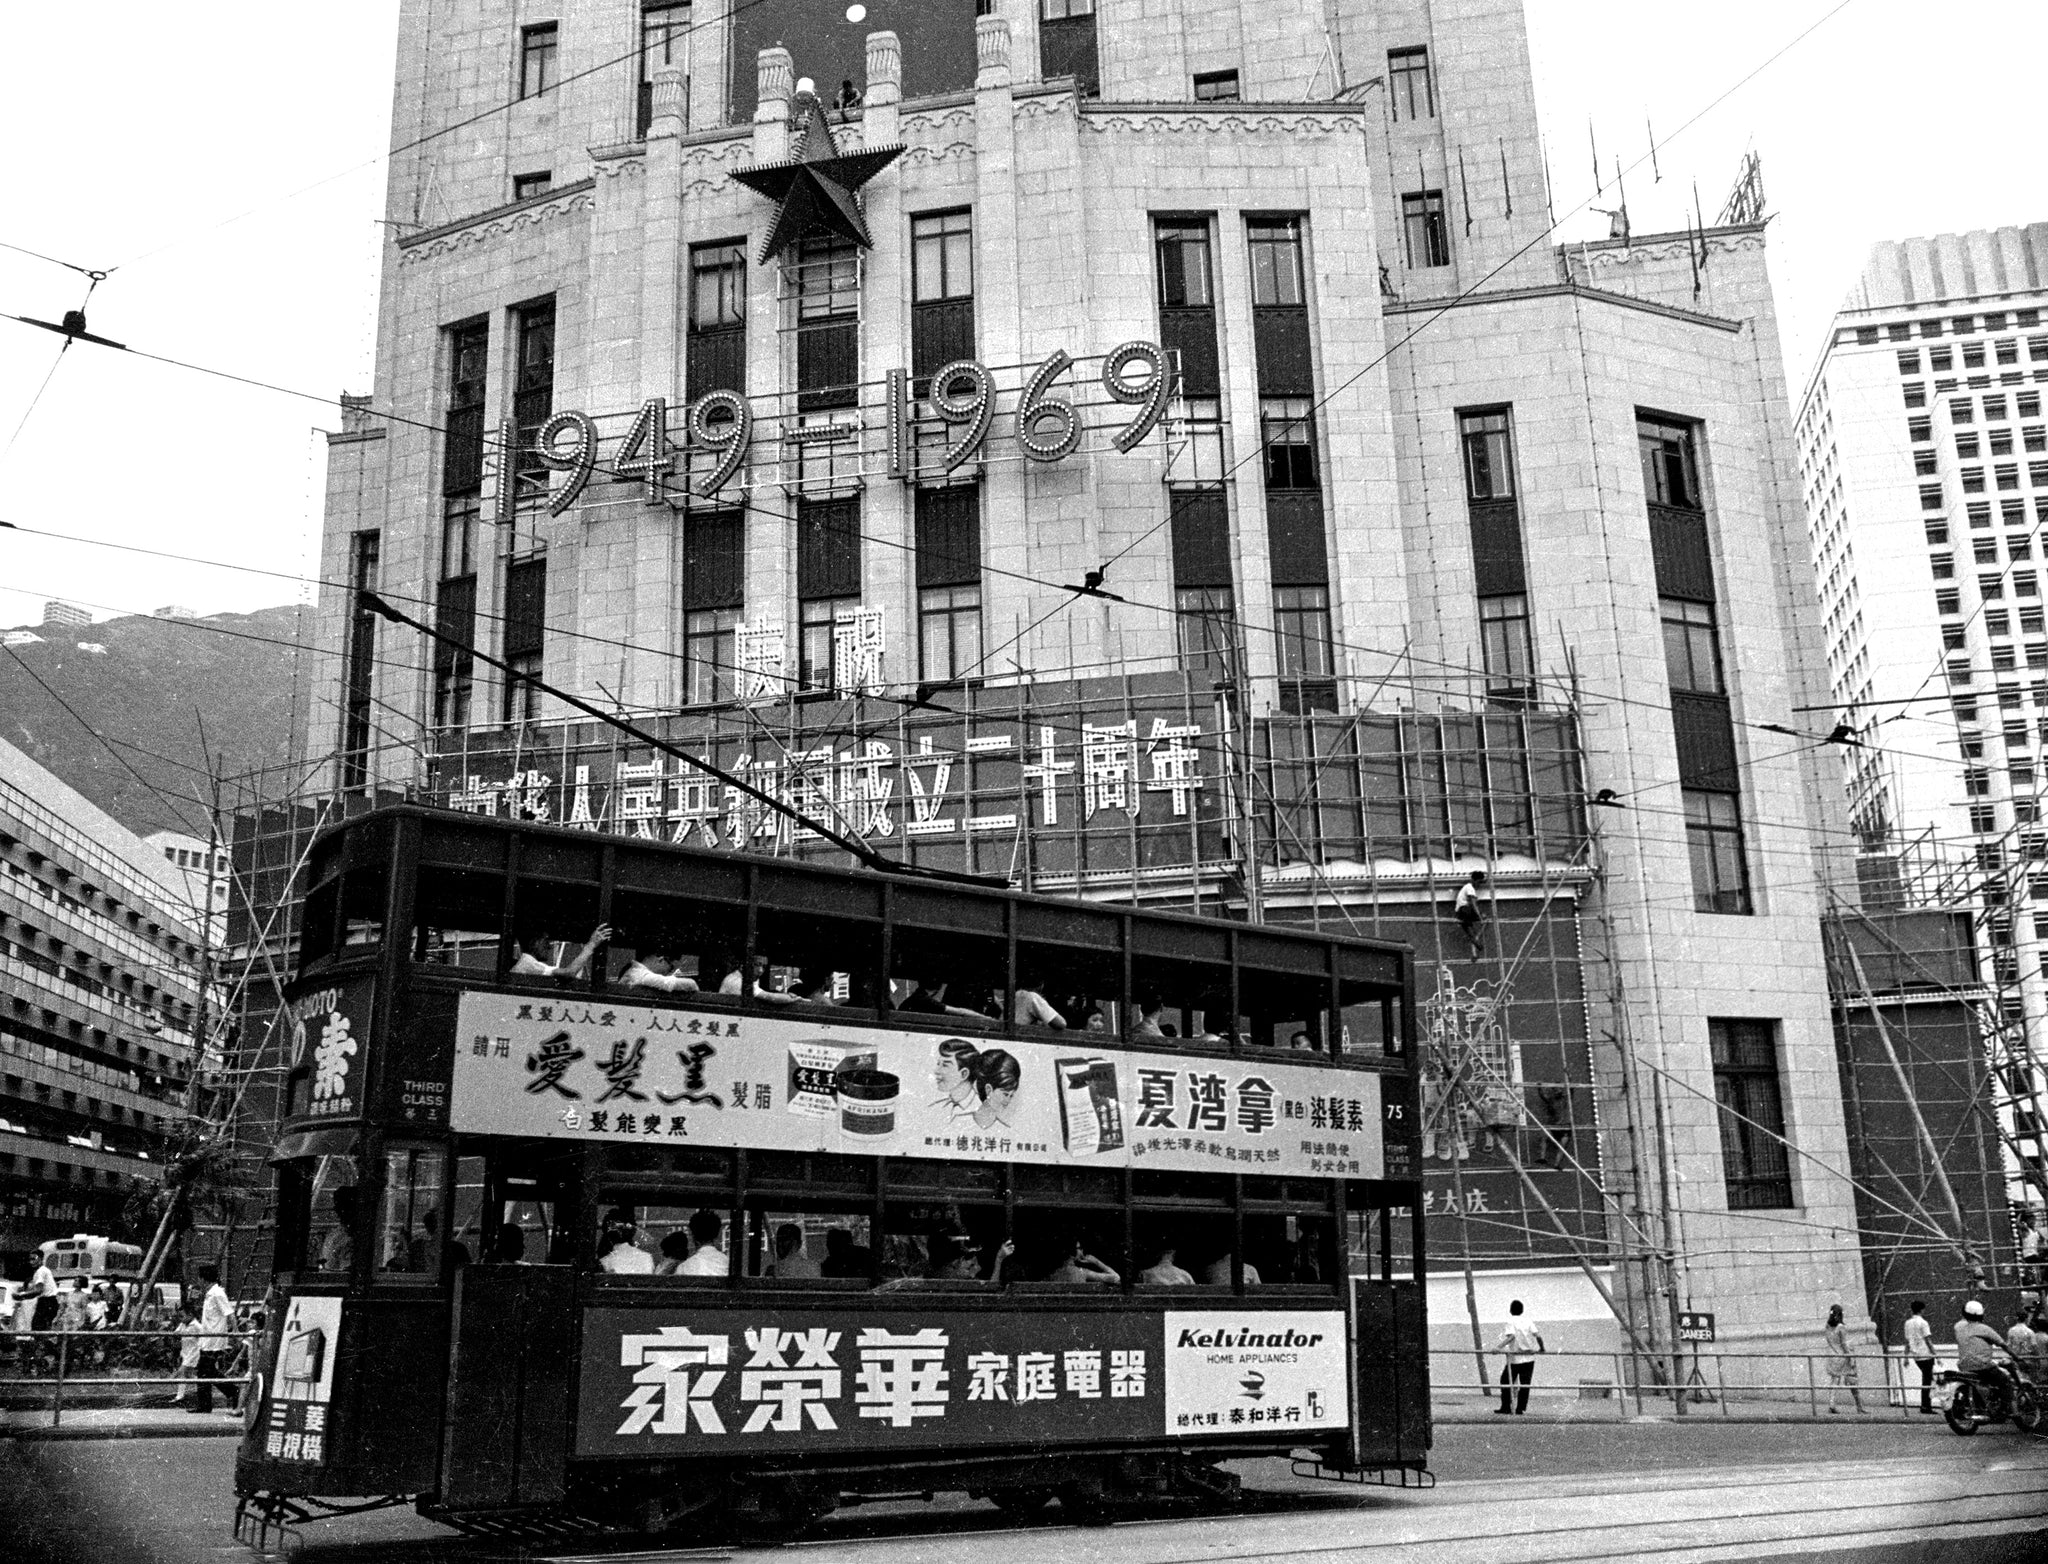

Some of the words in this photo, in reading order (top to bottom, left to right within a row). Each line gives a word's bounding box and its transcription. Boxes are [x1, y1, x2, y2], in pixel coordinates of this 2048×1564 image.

[472, 1035, 511, 1059] 請用
[523, 1029, 724, 1111] 愛髮黑
[403, 1080, 445, 1093] THIRD
[402, 1094, 443, 1106] CLASS
[1387, 1105, 1403, 1119] 75
[1177, 1328, 1323, 1348] Kelvinator
[1680, 1329, 1712, 1341] DANGER
[1207, 1354, 1234, 1364] HOME
[1239, 1353, 1298, 1364] APPLIANCES
[615, 1326, 949, 1435] 家榮華
[967, 1350, 1146, 1401] 家庭電器
[270, 1403, 325, 1432] 三菱
[266, 1430, 323, 1461] 電視機
